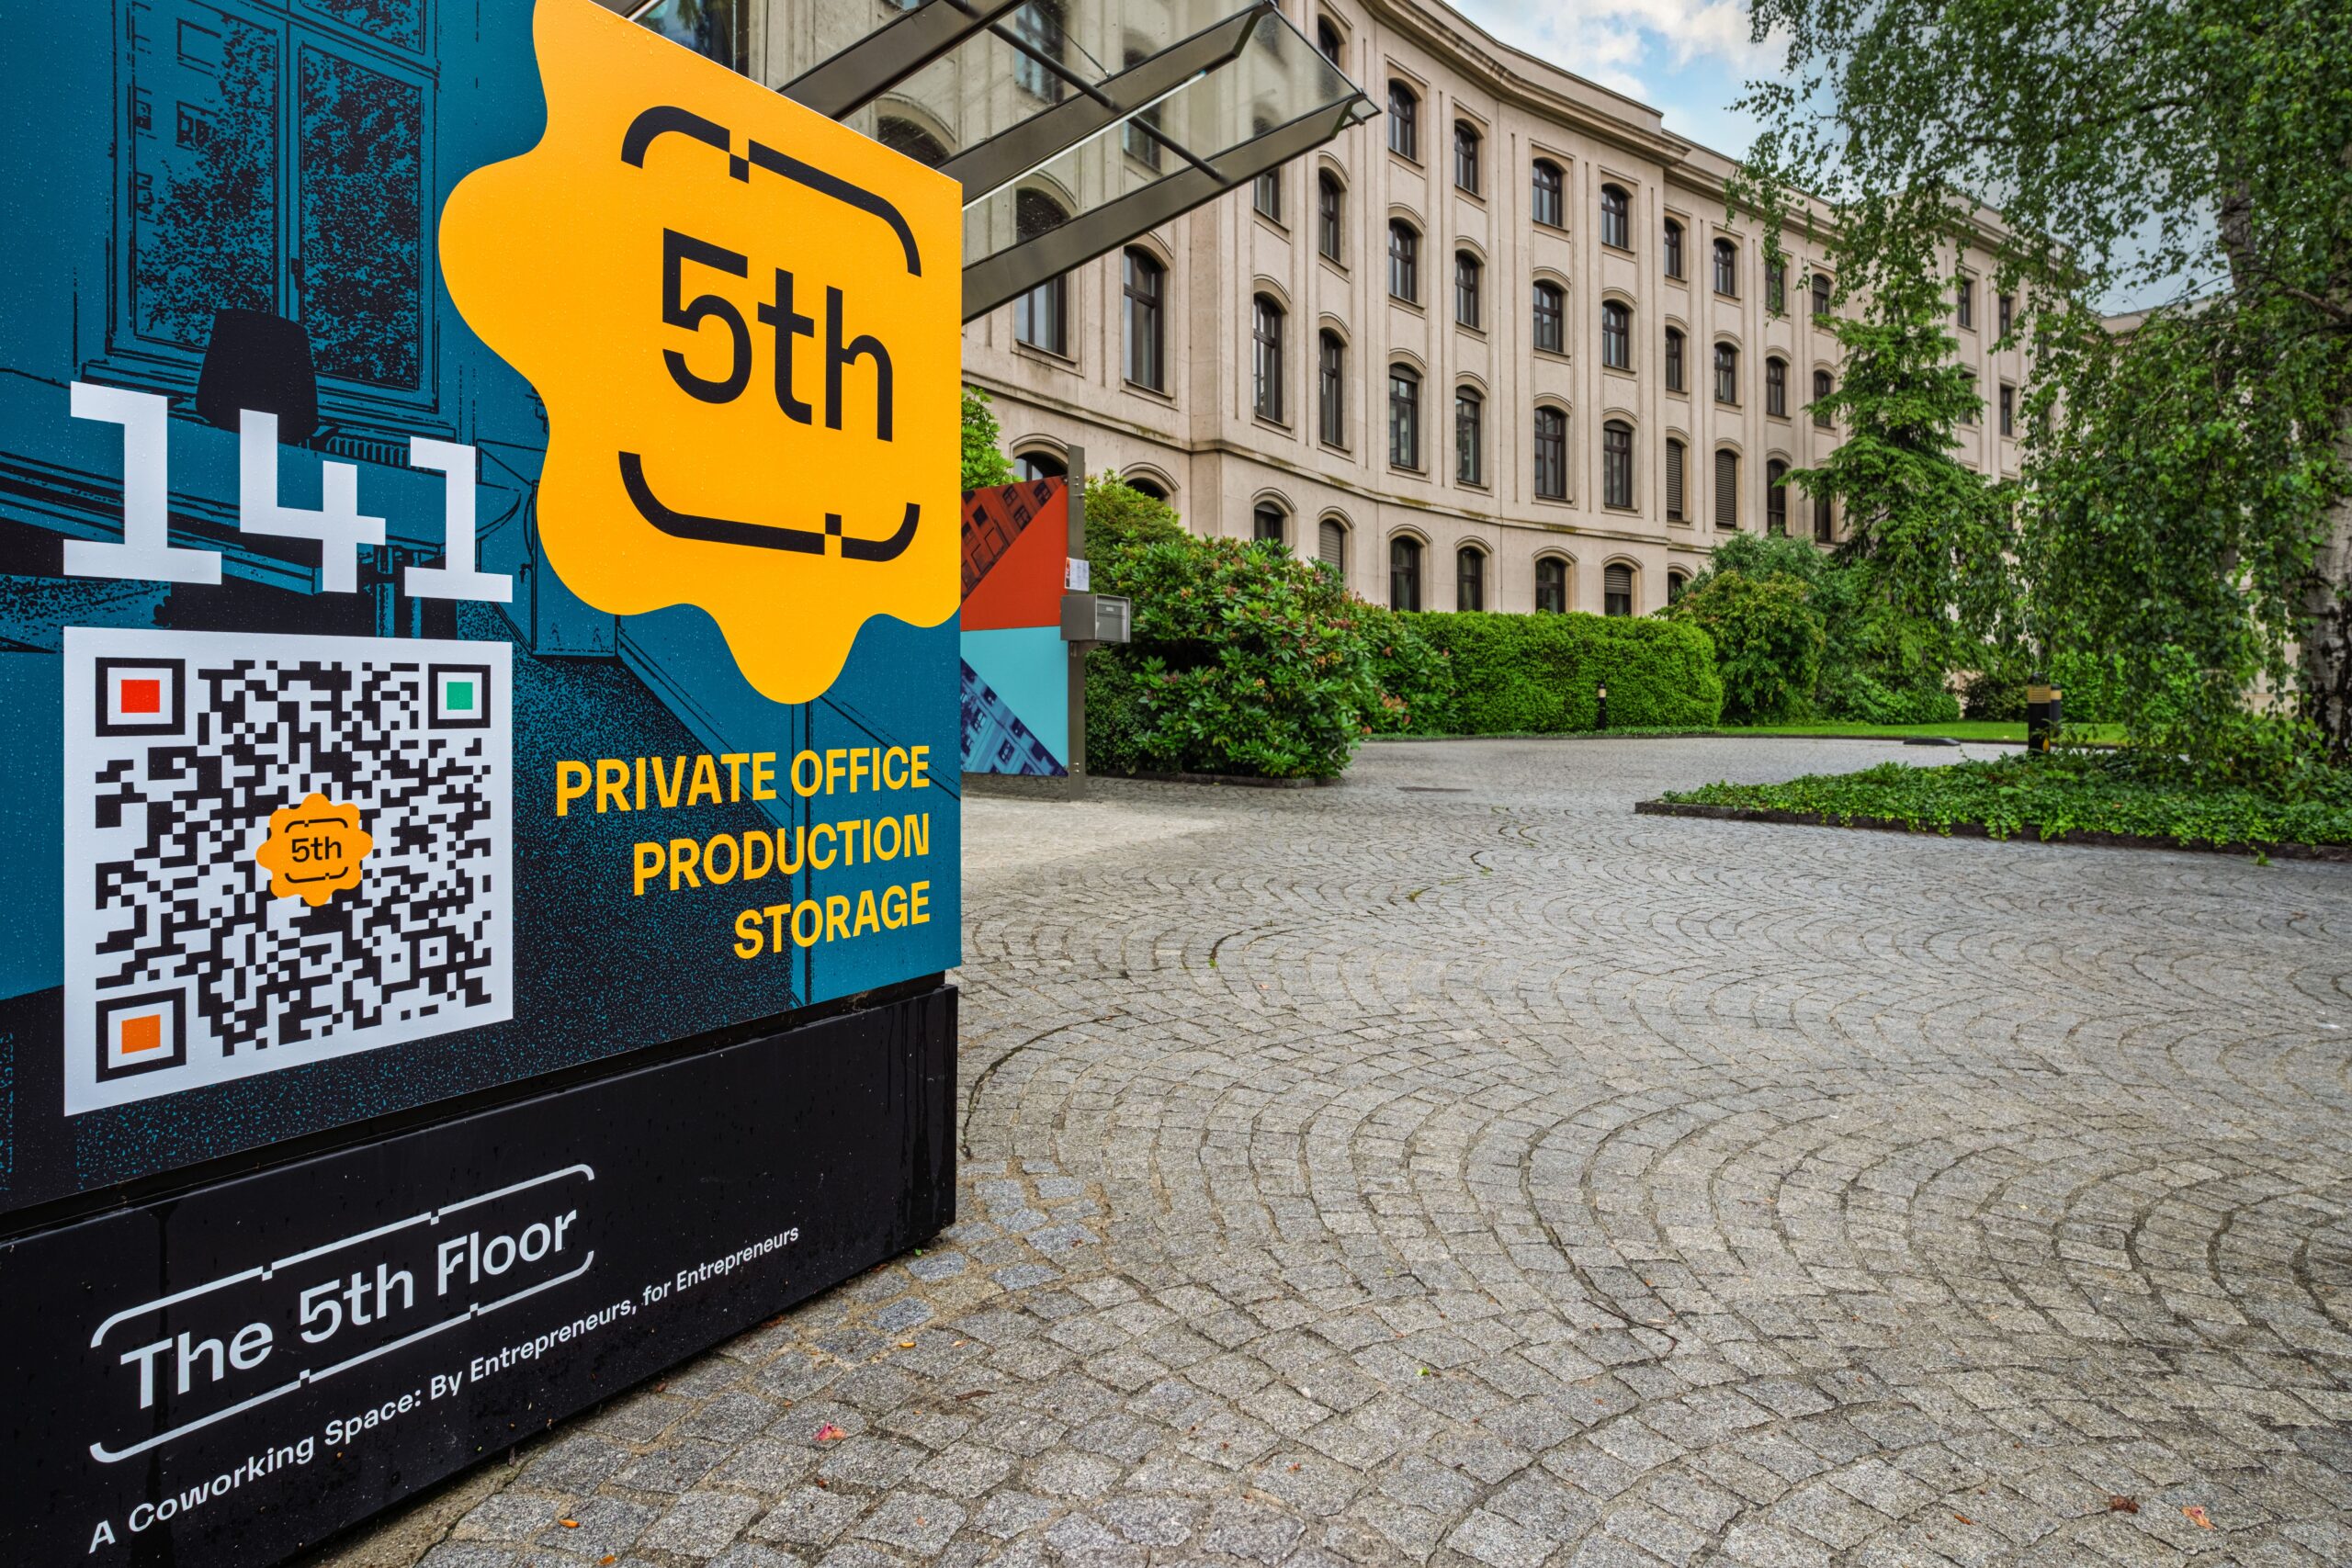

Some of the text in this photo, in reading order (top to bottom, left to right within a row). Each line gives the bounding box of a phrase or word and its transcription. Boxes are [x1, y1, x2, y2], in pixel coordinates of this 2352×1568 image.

[662, 227, 893, 443] 5th
[63, 381, 513, 603] 141
[291, 836, 342, 863] 5th
[556, 745, 930, 817] PRIVATE OFFICE
[633, 813, 929, 896] PRODUCTION
[733, 880, 930, 960] STORAGE
[120, 1209, 577, 1410] The 5th Floor
[89, 1227, 799, 1554] A Coworking Space: By Entrepreneurs, for Entrepreneurs
